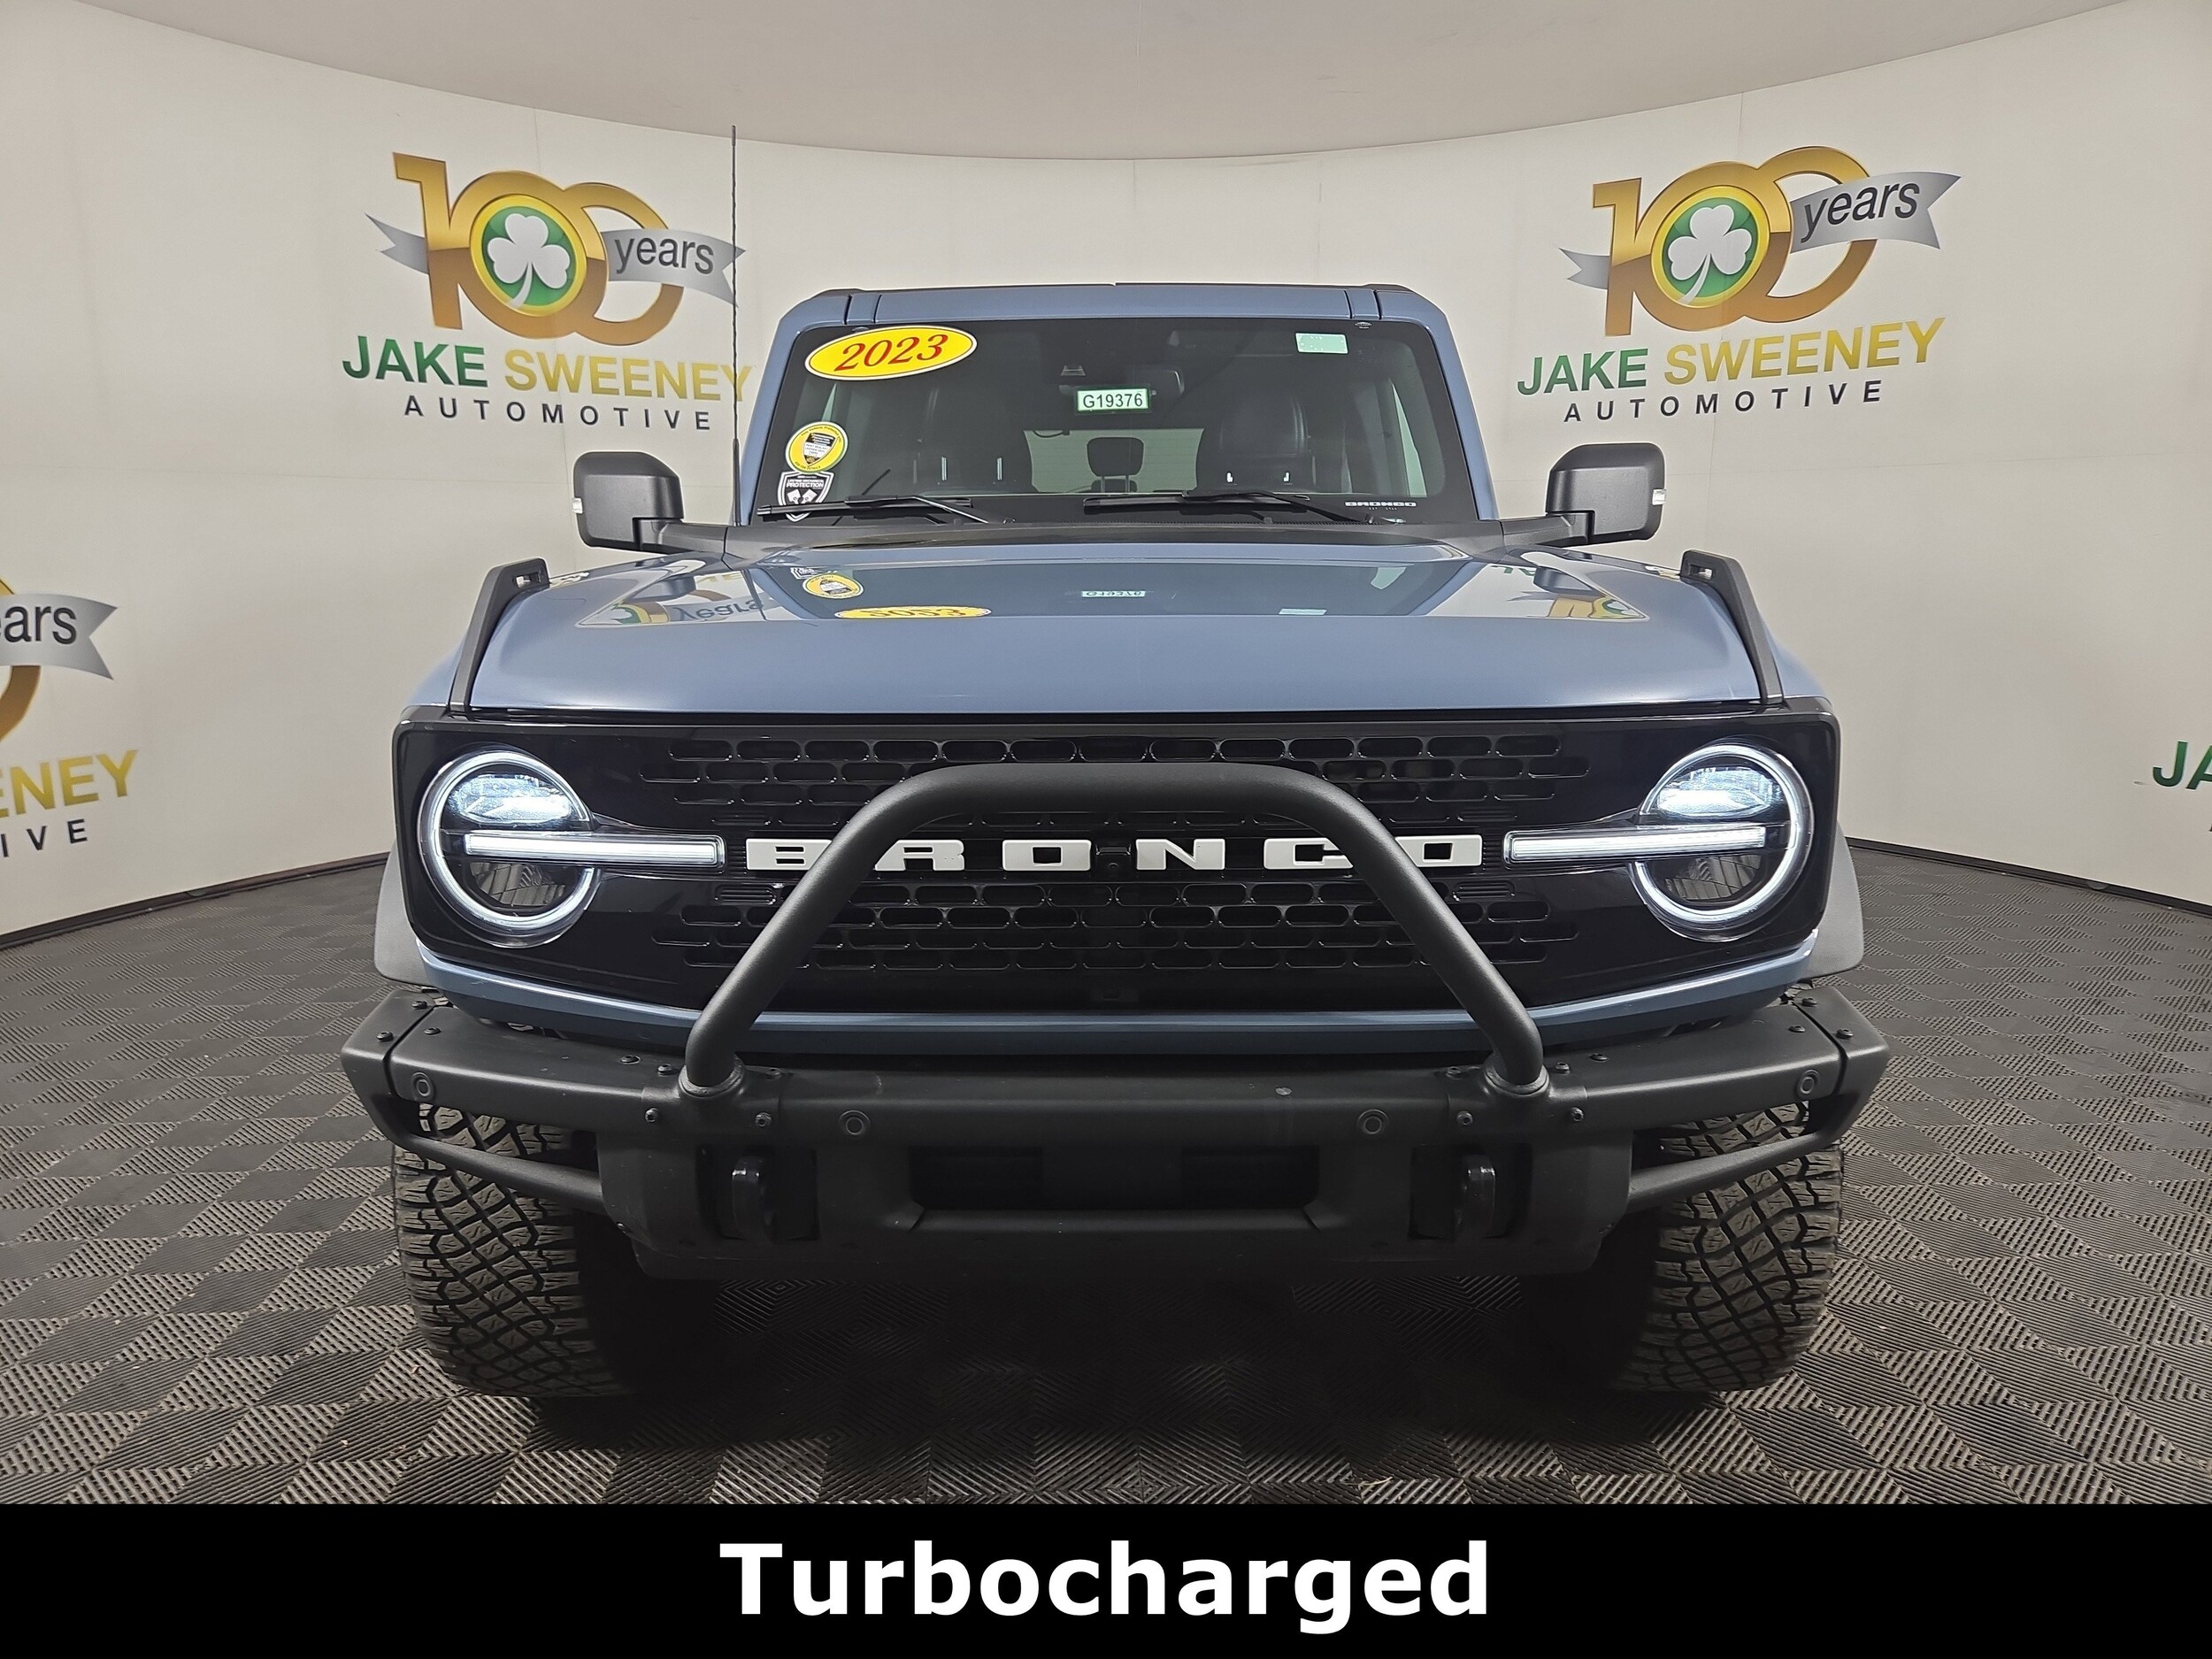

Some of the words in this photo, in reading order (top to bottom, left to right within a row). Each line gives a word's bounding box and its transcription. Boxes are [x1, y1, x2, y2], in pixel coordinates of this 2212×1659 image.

[393, 151, 685, 347] 100
[615, 235, 715, 275] years
[1592, 144, 1878, 338] 100
[1800, 181, 1921, 244] years
[342, 335, 488, 388] JAKE
[503, 349, 753, 403] SWEENEY
[833, 334, 949, 373] 2023
[1517, 347, 1649, 396] JAKE
[1663, 317, 1947, 386] SWEENEY
[403, 395, 711, 431] AUTOMOTIVE
[1083, 394, 1143, 409] G19376
[1563, 380, 1883, 423] AUTOMOTIVE
[0, 605, 78, 645] ars
[0, 749, 139, 818] NEY
[745, 834, 1483, 872] BRONCO
